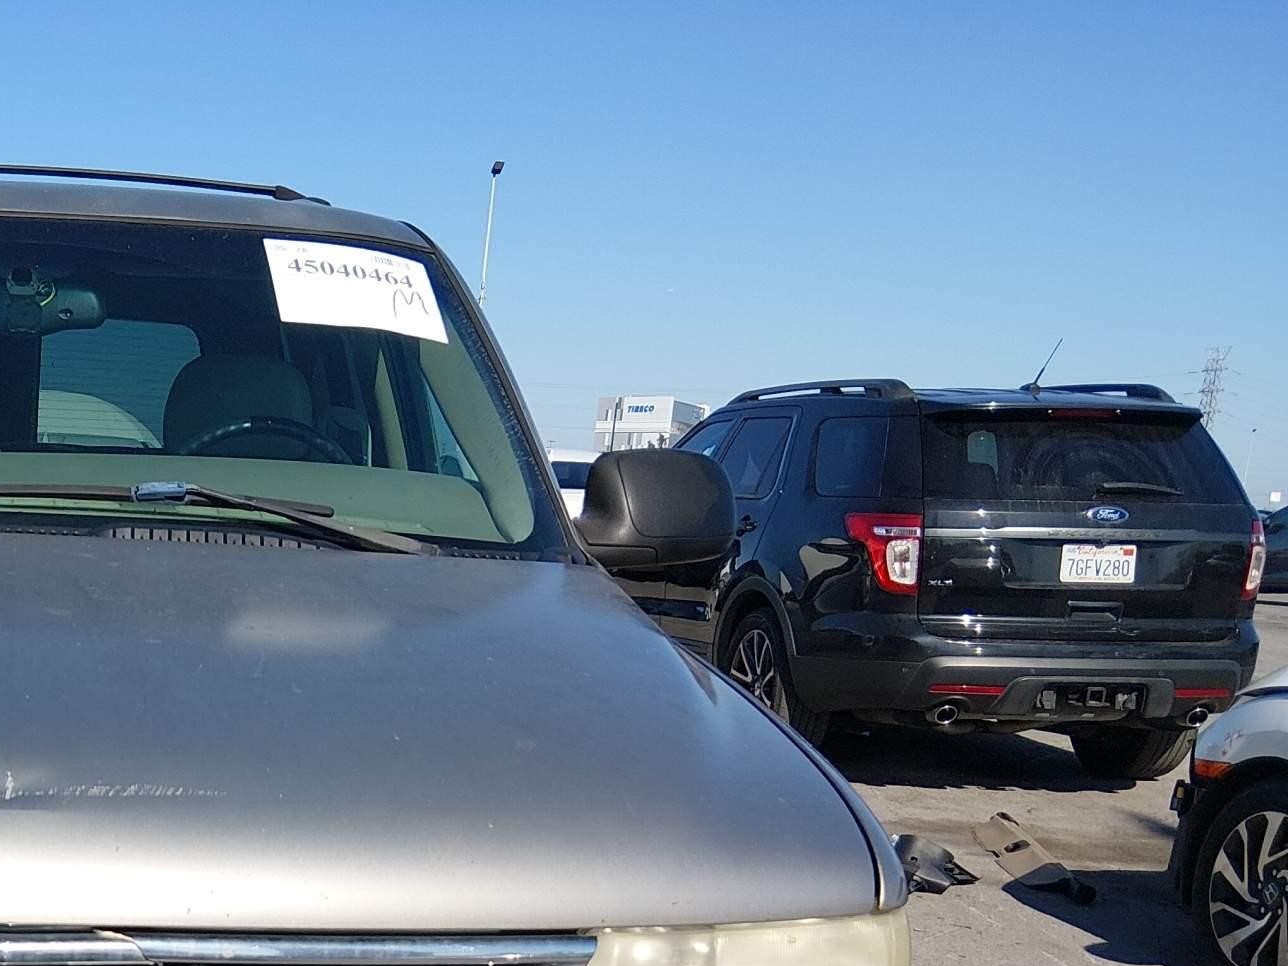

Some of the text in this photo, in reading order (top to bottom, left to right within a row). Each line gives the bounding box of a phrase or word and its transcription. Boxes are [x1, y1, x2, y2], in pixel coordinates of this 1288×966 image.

[287, 258, 413, 288] 45040464
[1096, 509, 1121, 520] Ford
[1067, 558, 1131, 577] 7GFV280
